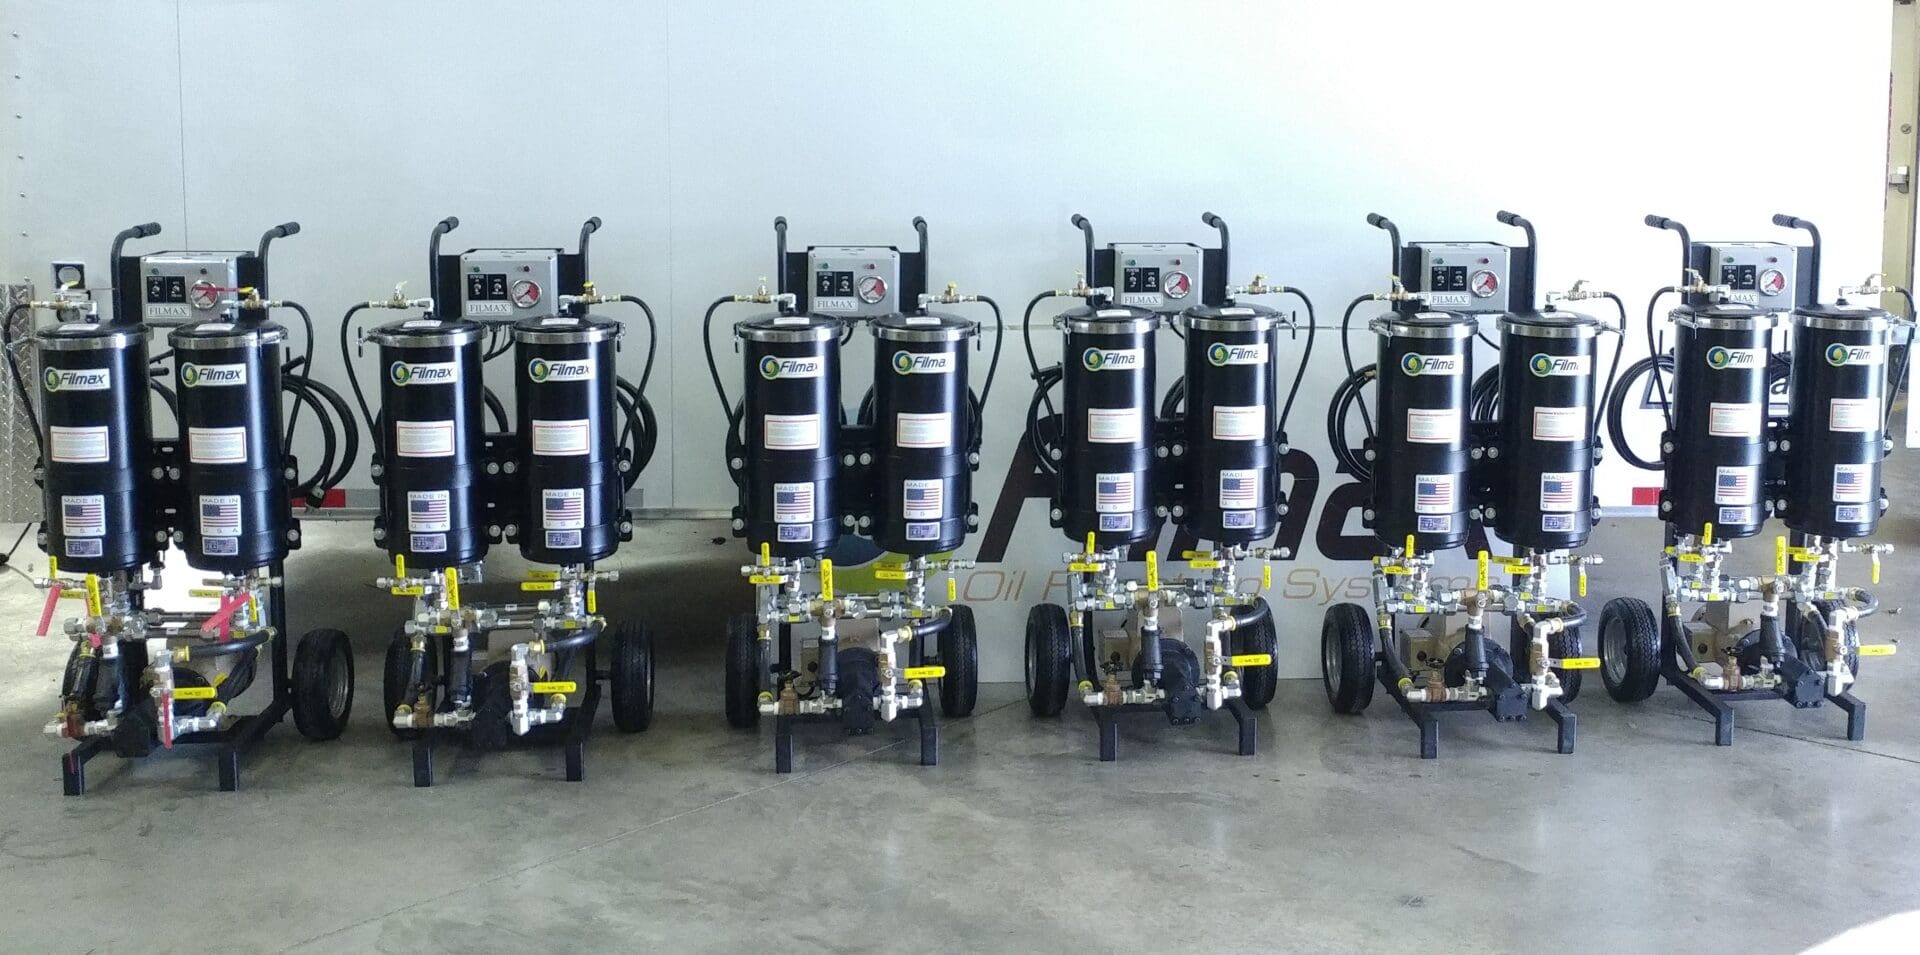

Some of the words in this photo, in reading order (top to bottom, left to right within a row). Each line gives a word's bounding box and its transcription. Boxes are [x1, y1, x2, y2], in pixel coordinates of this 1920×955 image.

[817, 300, 854, 308] FILMAX
[1124, 295, 1159, 304] FILMAX
[1432, 295, 1467, 303] FILMAX
[149, 307, 187, 315] FILMAX
[469, 304, 508, 312] FILMAX
[1103, 352, 1135, 364] Filma
[1229, 348, 1258, 360] Filma
[1728, 351, 1754, 363] Film
[1848, 348, 1871, 360] Film
[912, 356, 946, 368] Filma
[1422, 358, 1454, 370] Filma
[1551, 359, 1579, 371] Film
[198, 368, 242, 381] Filmax
[409, 366, 453, 379] Filmax
[548, 363, 590, 376] Filmax
[59, 372, 107, 385] Filmax
[963, 570, 1027, 602] Oil
[1284, 568, 1499, 606] Sysm
